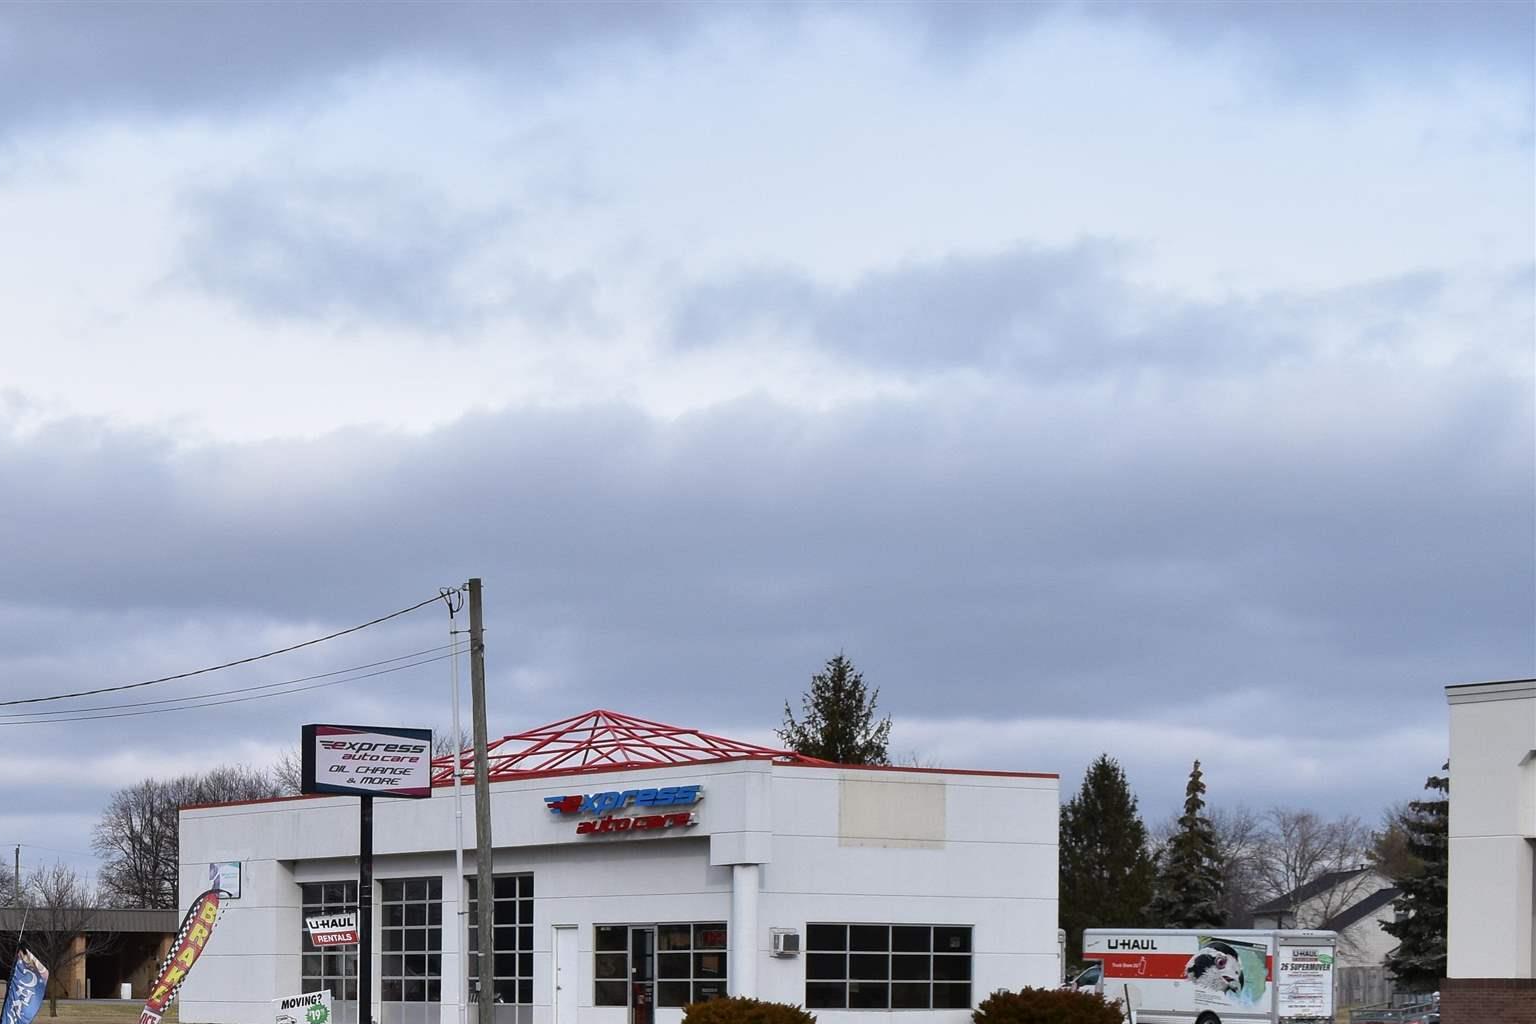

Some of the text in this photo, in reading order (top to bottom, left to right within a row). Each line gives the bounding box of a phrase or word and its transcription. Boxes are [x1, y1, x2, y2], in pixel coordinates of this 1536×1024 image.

[321, 740, 426, 754] express
[329, 765, 414, 775] OIL CHANGE
[360, 776, 402, 785] MORE
[550, 785, 702, 815] express
[309, 918, 354, 929] U-HAUL
[317, 932, 353, 943] RENTALS
[1107, 939, 1158, 950] U-HAUL
[281, 994, 322, 1010] MOVING?
